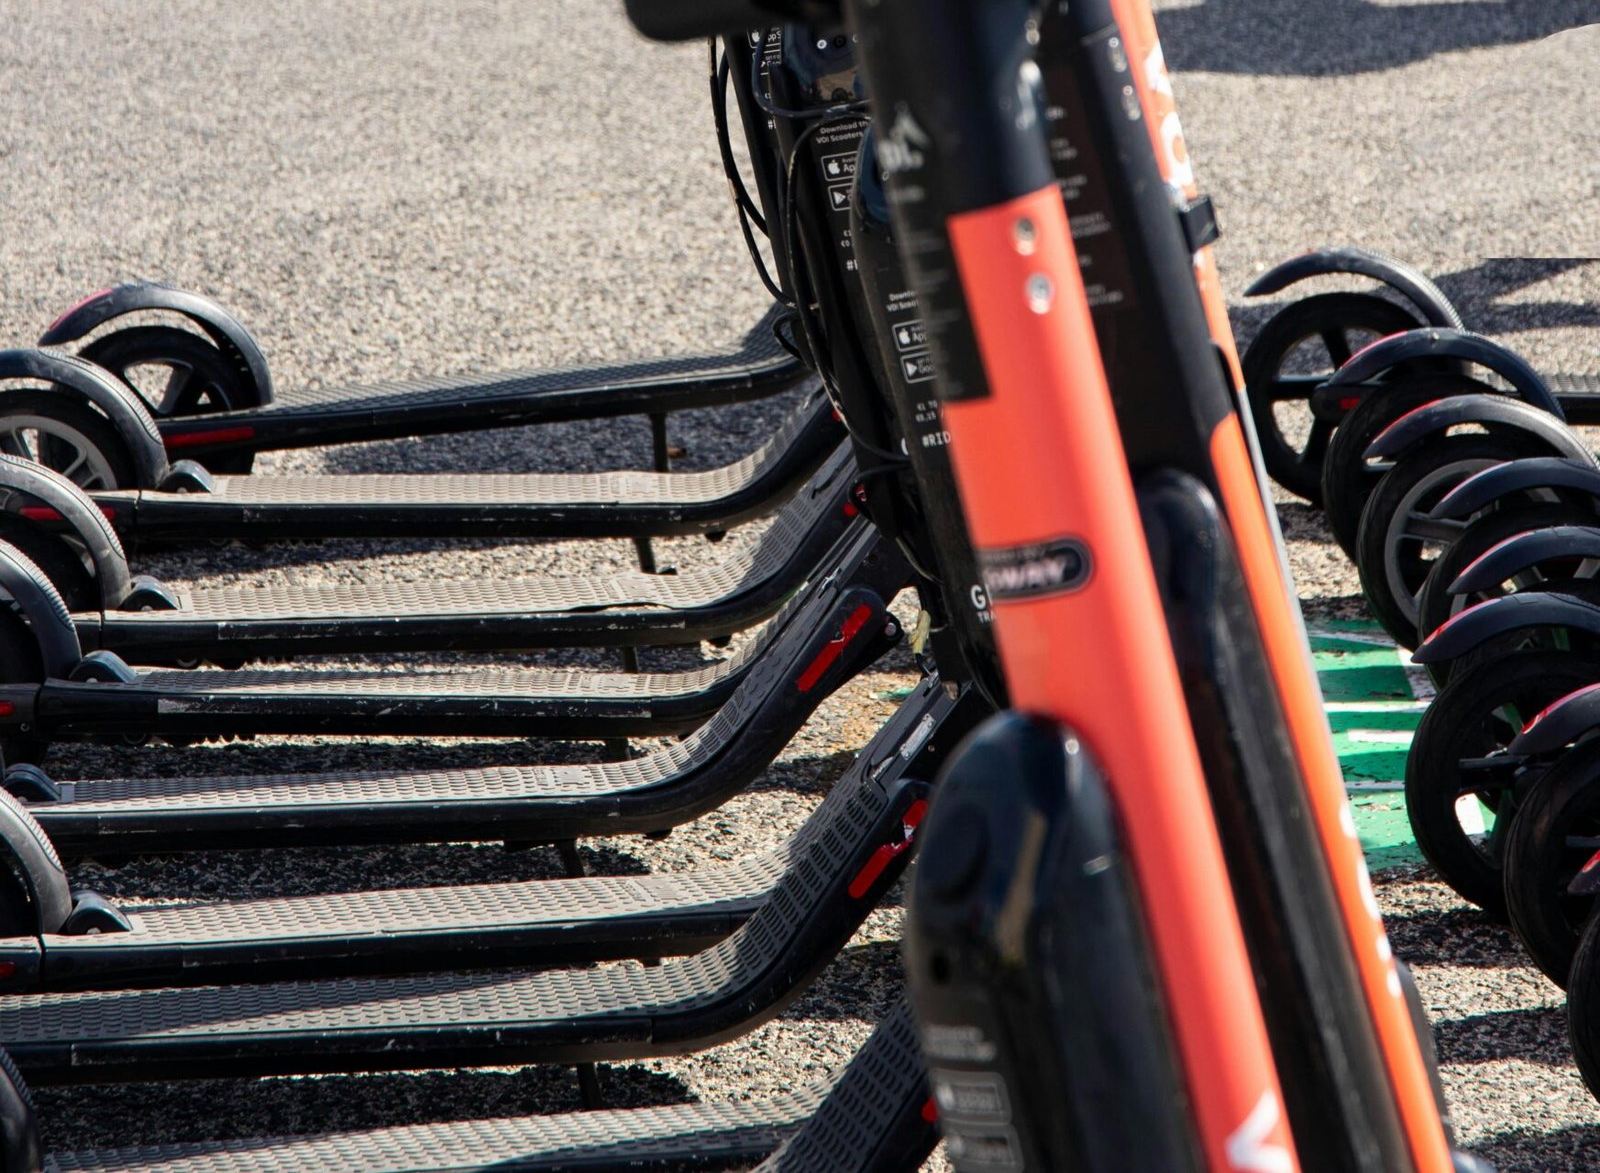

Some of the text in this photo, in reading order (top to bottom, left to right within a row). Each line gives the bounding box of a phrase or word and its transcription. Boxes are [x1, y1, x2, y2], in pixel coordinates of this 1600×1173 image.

[820, 122, 858, 135] Download
[843, 162, 856, 173] Ap
[922, 430, 952, 448] #RID
